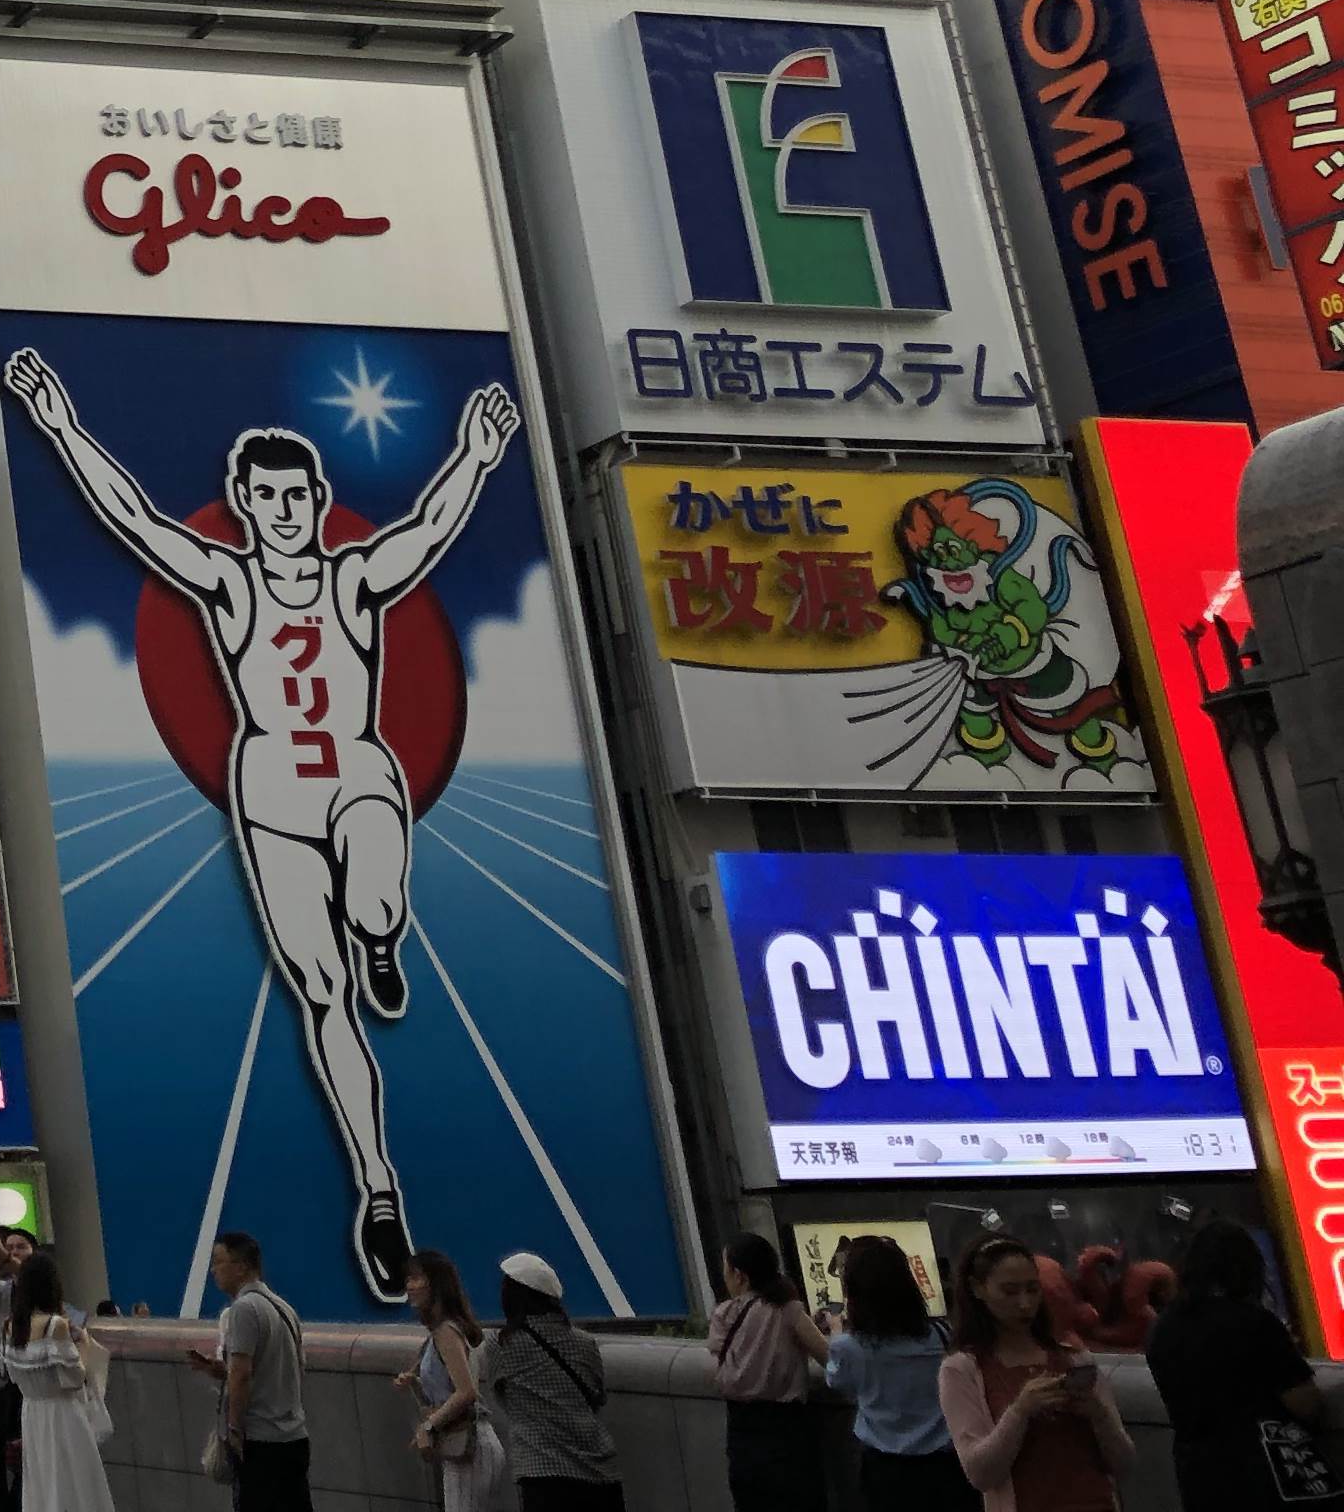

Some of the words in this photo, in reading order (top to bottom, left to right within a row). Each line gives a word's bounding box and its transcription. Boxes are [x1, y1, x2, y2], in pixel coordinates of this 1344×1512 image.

[100, 103, 344, 152] おいしさと健康
[84, 152, 392, 276] Glico
[625, 328, 1040, 408] 日商エステム
[666, 479, 850, 536] かぜに
[657, 544, 889, 640] 改源
[271, 615, 342, 781] グリコ
[763, 913, 1206, 1090] CHINTAI
[788, 1140, 860, 1167] 天気予報
